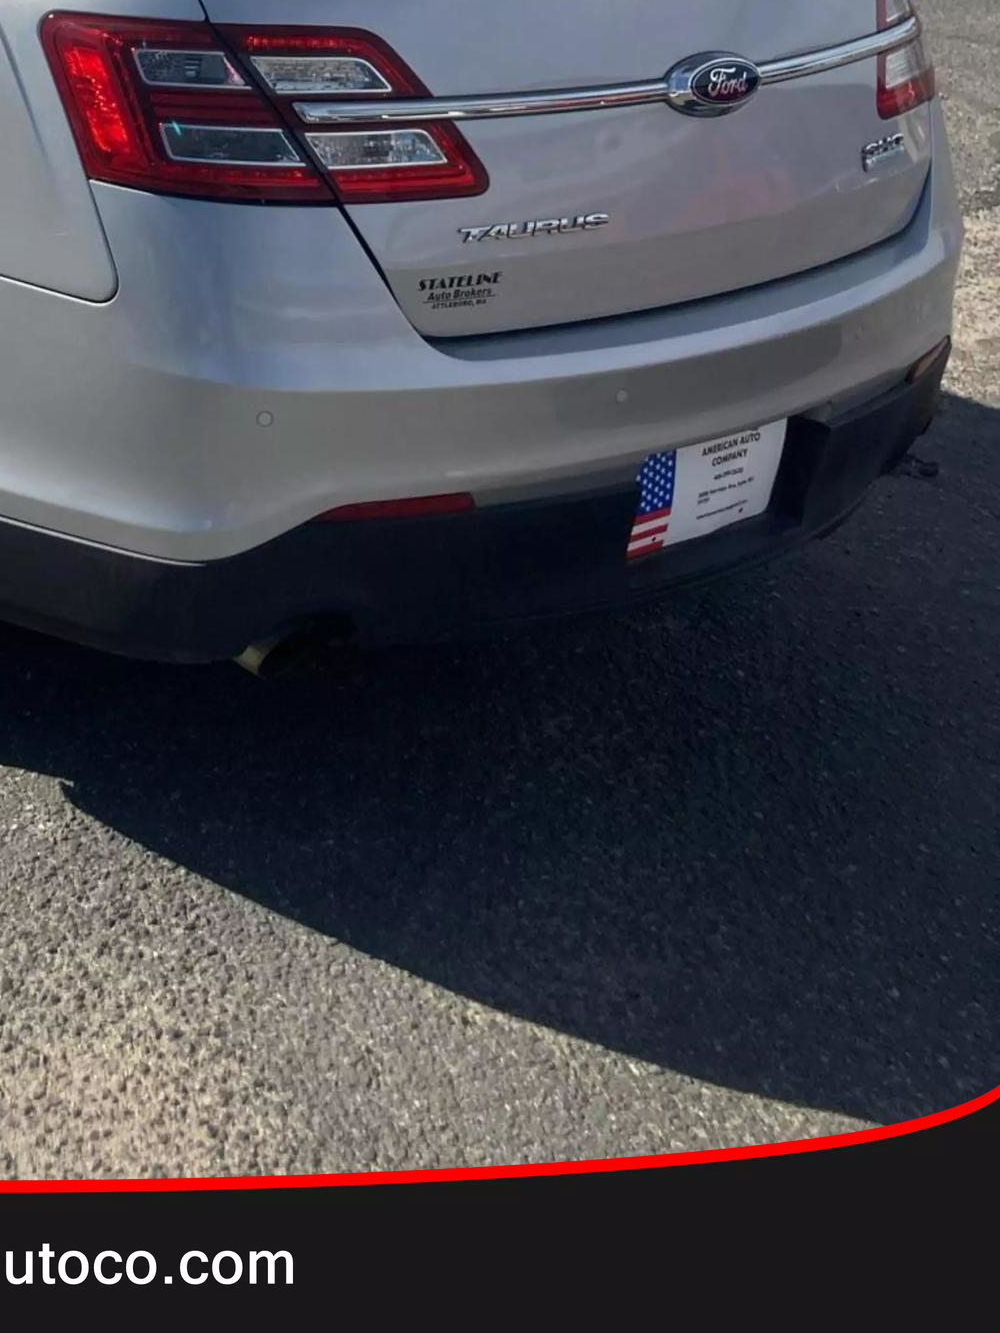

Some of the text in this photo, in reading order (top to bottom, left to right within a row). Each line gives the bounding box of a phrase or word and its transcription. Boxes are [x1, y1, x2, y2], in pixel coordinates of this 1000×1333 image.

[708, 67, 748, 97] Ford
[458, 211, 609, 243] TAURUS
[419, 271, 502, 291] STATELINE
[427, 287, 493, 301] Auto Brokers
[702, 432, 760, 456] AMERICAN AUTO
[712, 449, 748, 466] COMPANY
